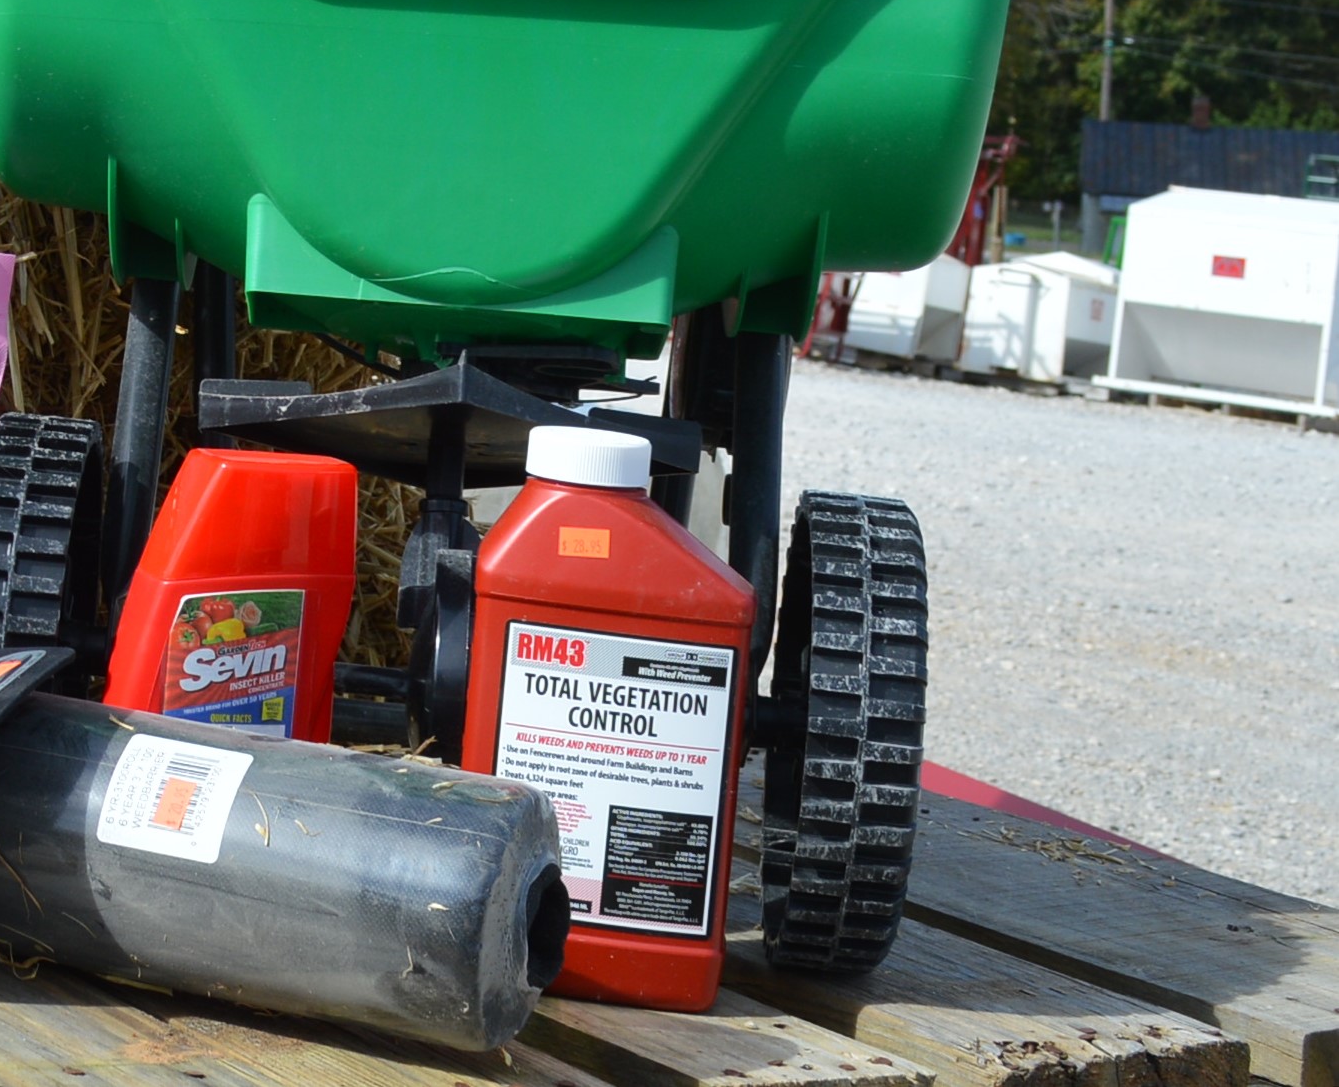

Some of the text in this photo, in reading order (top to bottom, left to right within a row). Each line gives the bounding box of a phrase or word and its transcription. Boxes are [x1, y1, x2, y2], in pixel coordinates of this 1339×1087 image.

[573, 539, 602, 554] 28.95
[517, 632, 586, 667] RM43
[179, 644, 287, 692] Sevin
[638, 666, 655, 677] With
[656, 668, 675, 680] Weed
[676, 671, 712, 683] Preventer
[229, 672, 286, 692] INSECT KILLER
[524, 672, 708, 716] TOTAL VEGETATION
[232, 697, 248, 707] OVER
[210, 713, 252, 723] QUICK FACTS
[568, 706, 658, 738] CONTROL
[506, 744, 518, 754] Use
[529, 748, 565, 762] Fencerows
[566, 753, 580, 762] and
[580, 755, 606, 766] around
[606, 758, 624, 769] Farm
[625, 760, 658, 774] Buildings
[659, 765, 672, 775] and
[673, 767, 693, 777] Barns
[516, 732, 536, 743] KILLS
[538, 735, 566, 747] WEEDS
[566, 740, 584, 750] AND
[584, 742, 625, 756] PREVENTS
[626, 747, 654, 760] WEEDS
[655, 751, 667, 761] UP
[667, 753, 679, 762] TO
[685, 755, 707, 765] YEAR
[504, 770, 584, 789] Treats 4,324 square feet
[505, 757, 704, 791] Do not apply in root zone of desirable trees, plants & shrubs
[123, 785, 136, 815] YEAR
[557, 792, 578, 801] areas:
[562, 836, 590, 848] CHILDREN
